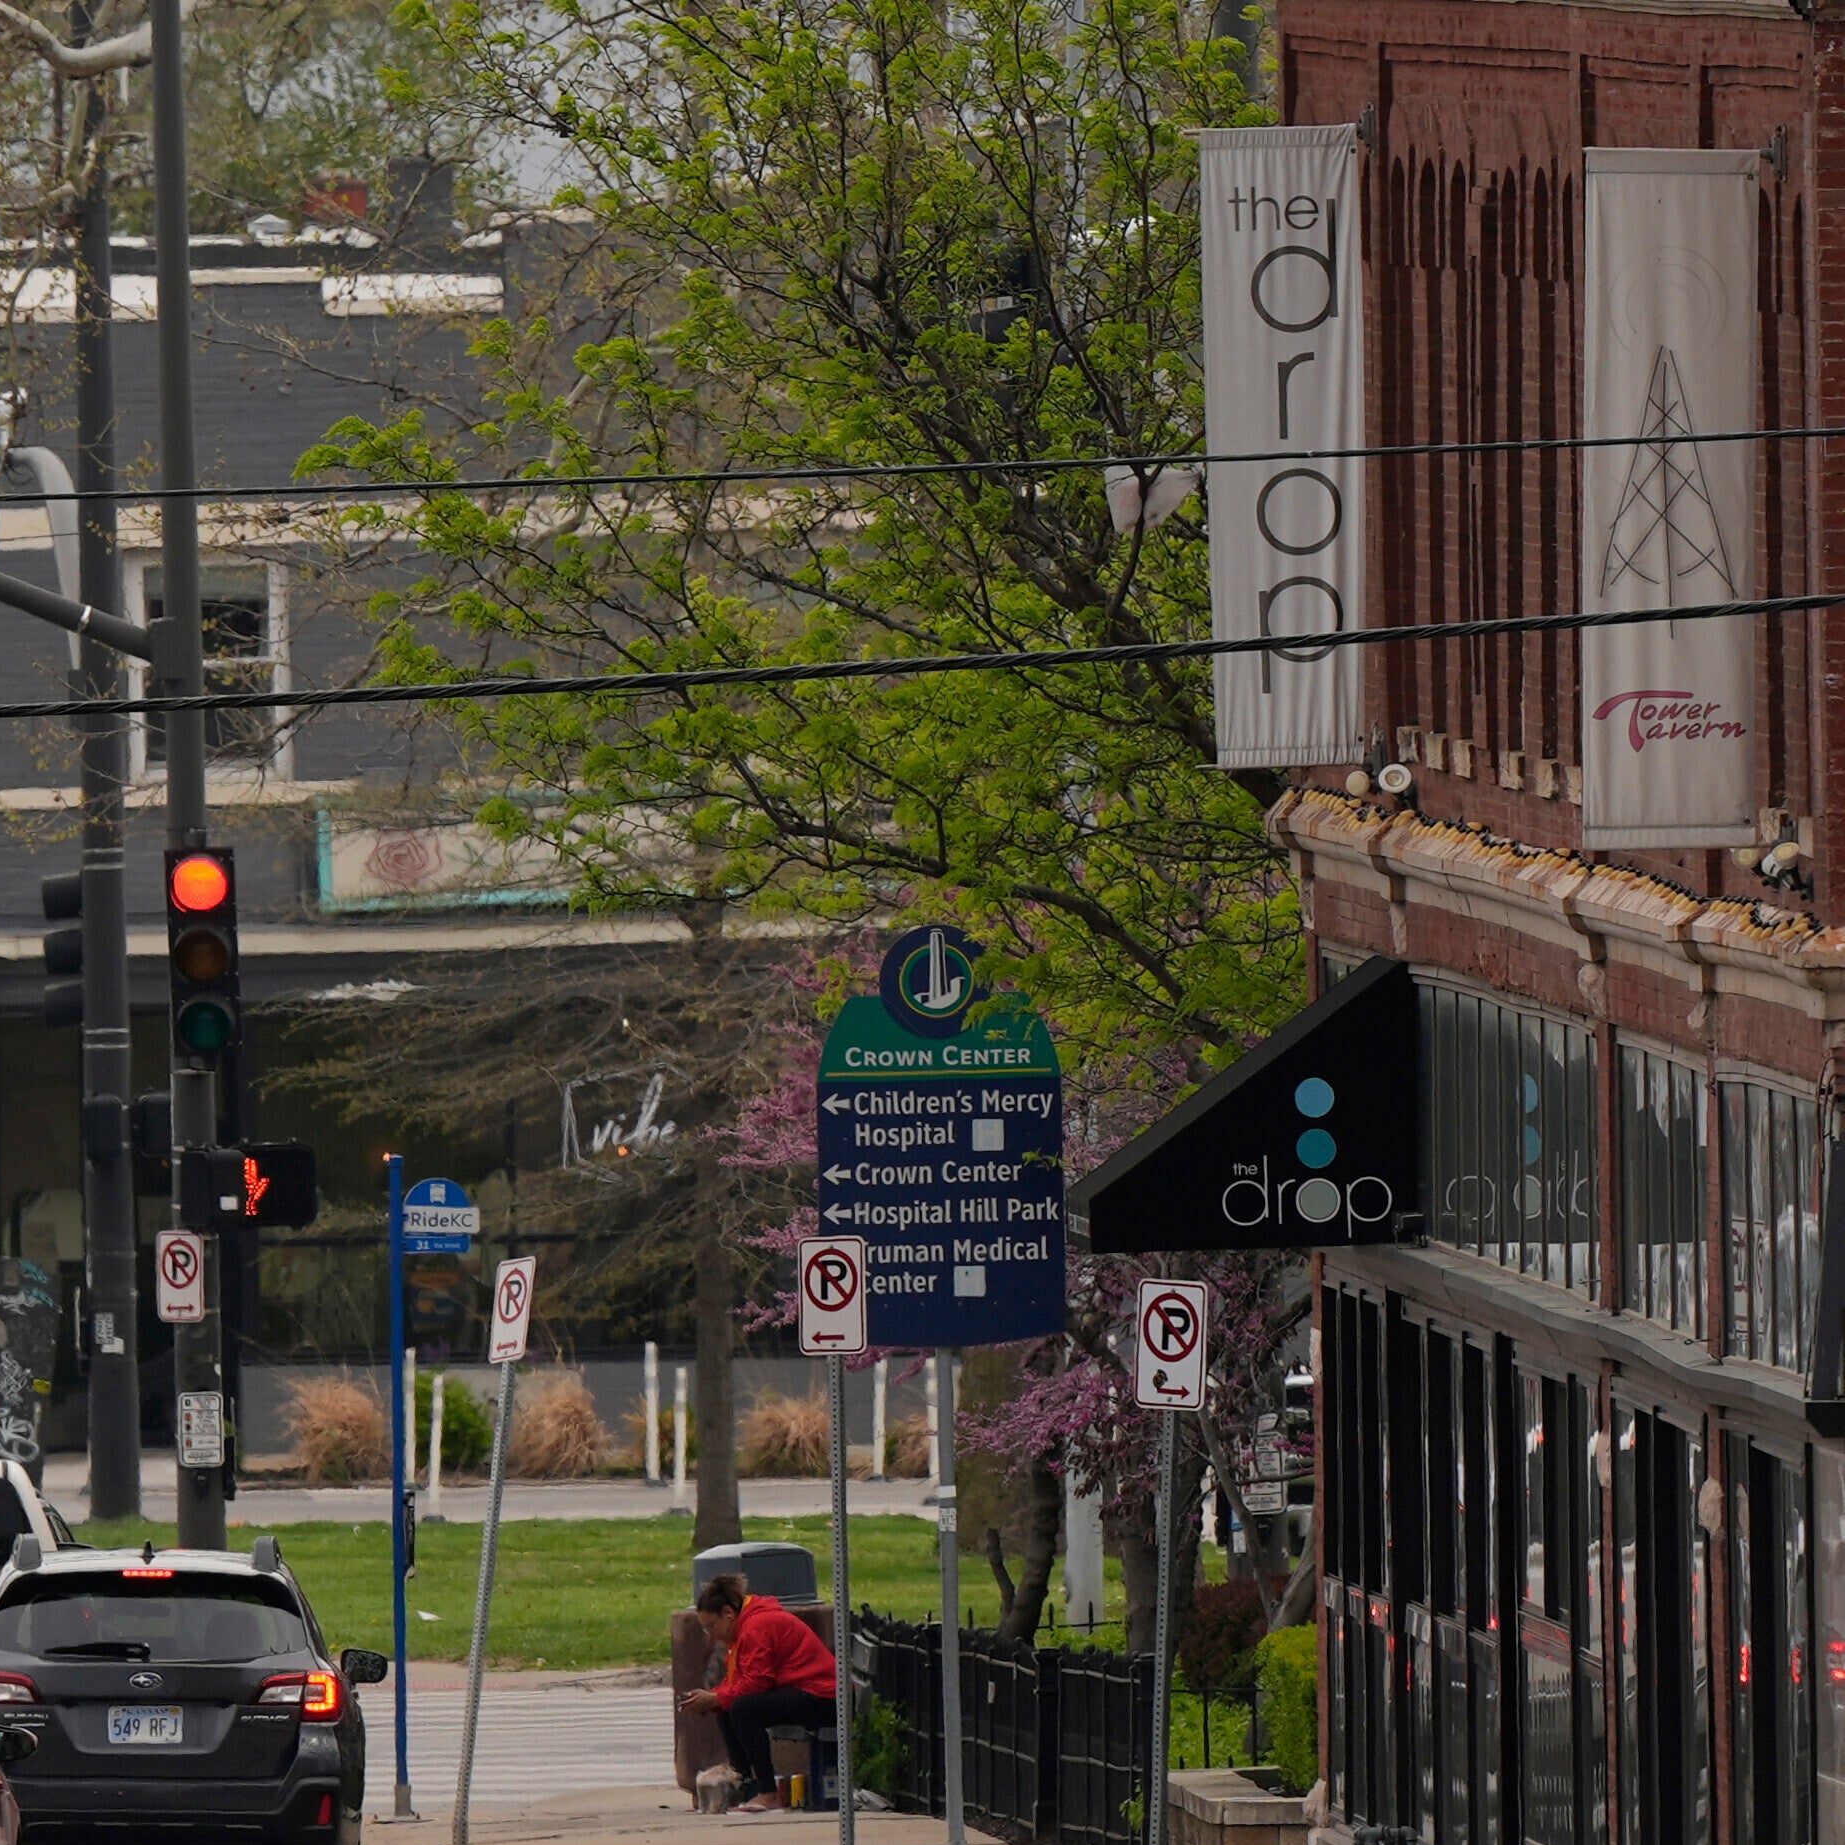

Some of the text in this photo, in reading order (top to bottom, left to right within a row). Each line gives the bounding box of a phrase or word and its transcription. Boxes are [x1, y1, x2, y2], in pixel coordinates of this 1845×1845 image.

[1228, 187, 1319, 231] the
[1250, 198, 1343, 694] drop
[844, 1045, 1031, 1068] CROWN CENTER
[853, 1089, 1054, 1119] Children's Mercy
[855, 1120, 956, 1152] Hospital
[855, 1160, 1023, 1186] Crown Center
[1232, 1162, 1259, 1176] the
[1222, 1154, 1393, 1239] drop
[410, 1211, 474, 1228] RideKC
[853, 1195, 1060, 1231] Hospital Hill Park
[415, 1240, 431, 1251] 31
[953, 1235, 1049, 1263] Medical
[865, 1271, 938, 1294] enter
[113, 1717, 179, 1737] 549 RFJ
